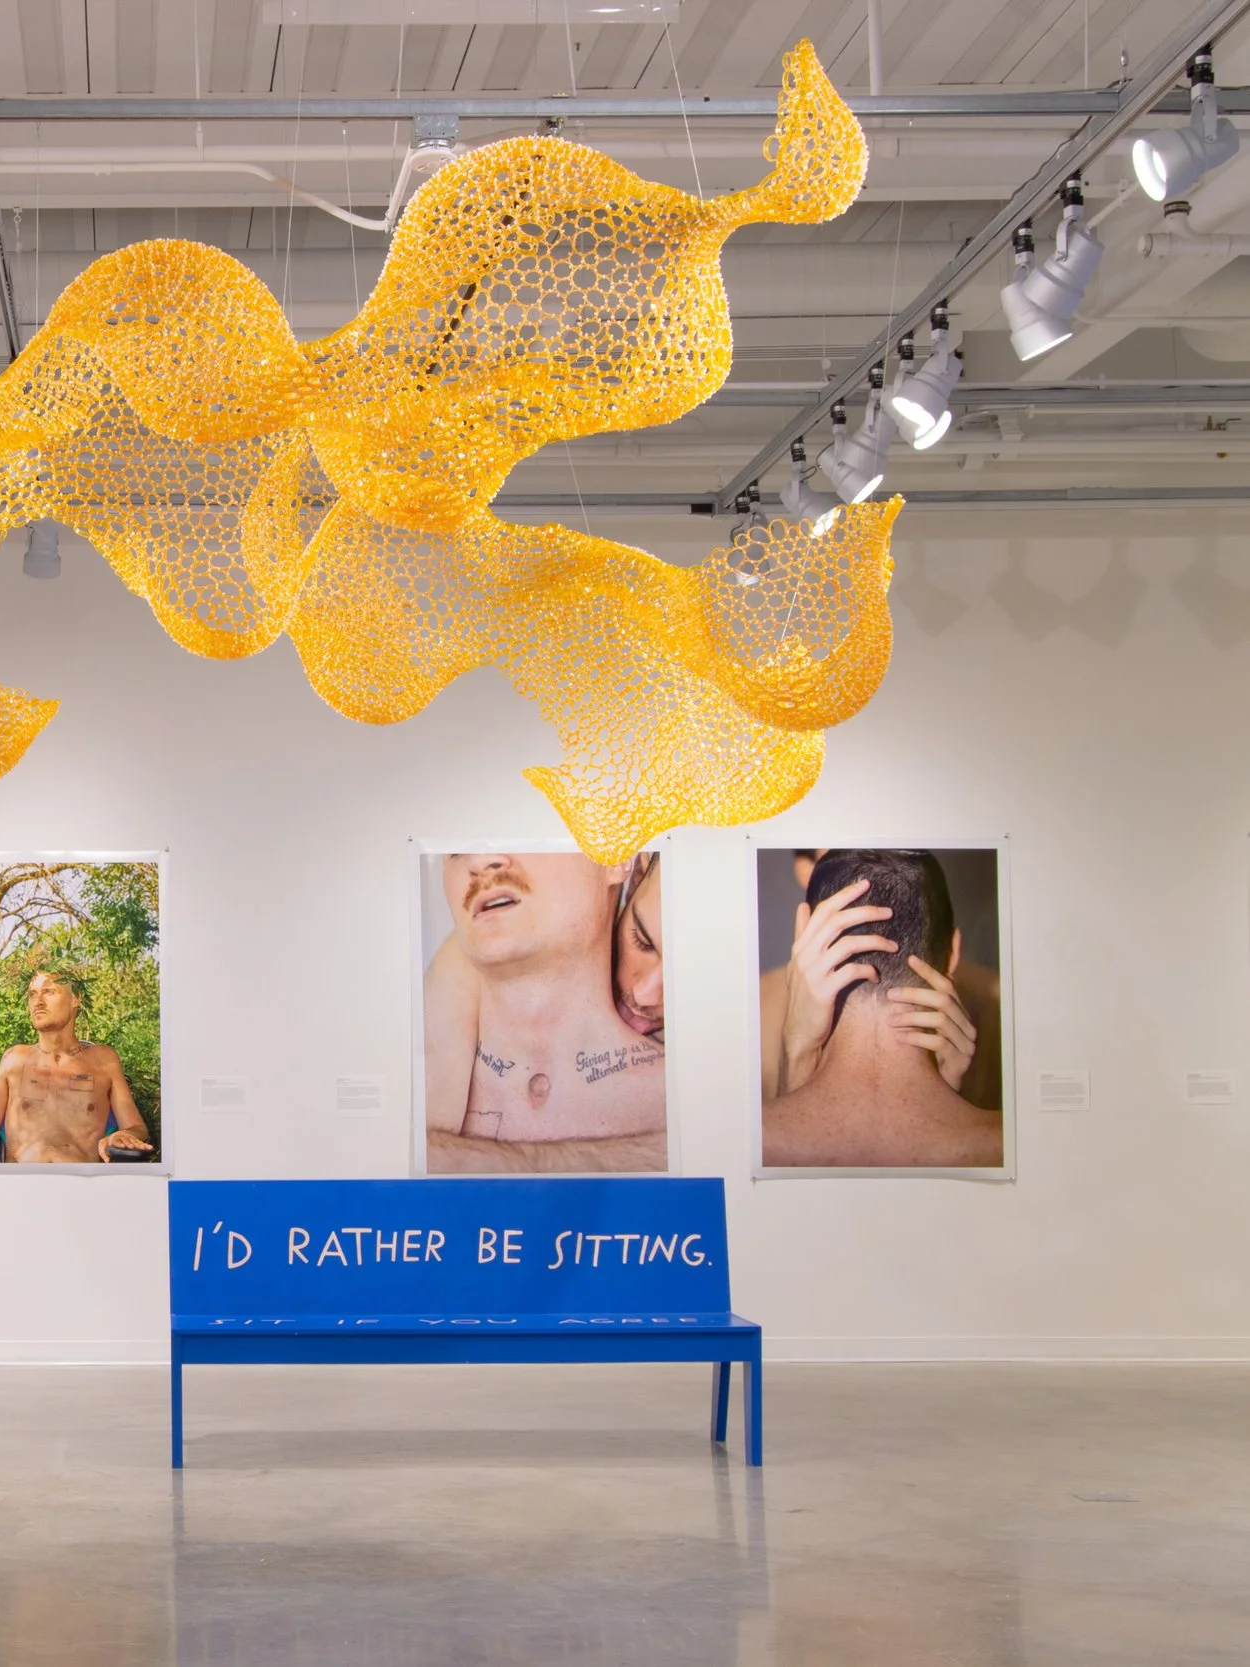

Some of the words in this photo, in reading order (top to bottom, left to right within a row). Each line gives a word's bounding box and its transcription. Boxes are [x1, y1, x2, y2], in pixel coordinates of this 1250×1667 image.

[575, 1050, 612, 1072] Giving
[615, 1047, 628, 1060] up
[585, 1058, 629, 1084] ultimate
[193, 1221, 252, 1271] I'D
[288, 1227, 446, 1266] RATHER
[477, 1227, 524, 1264] BE
[548, 1230, 713, 1270] SITTING.
